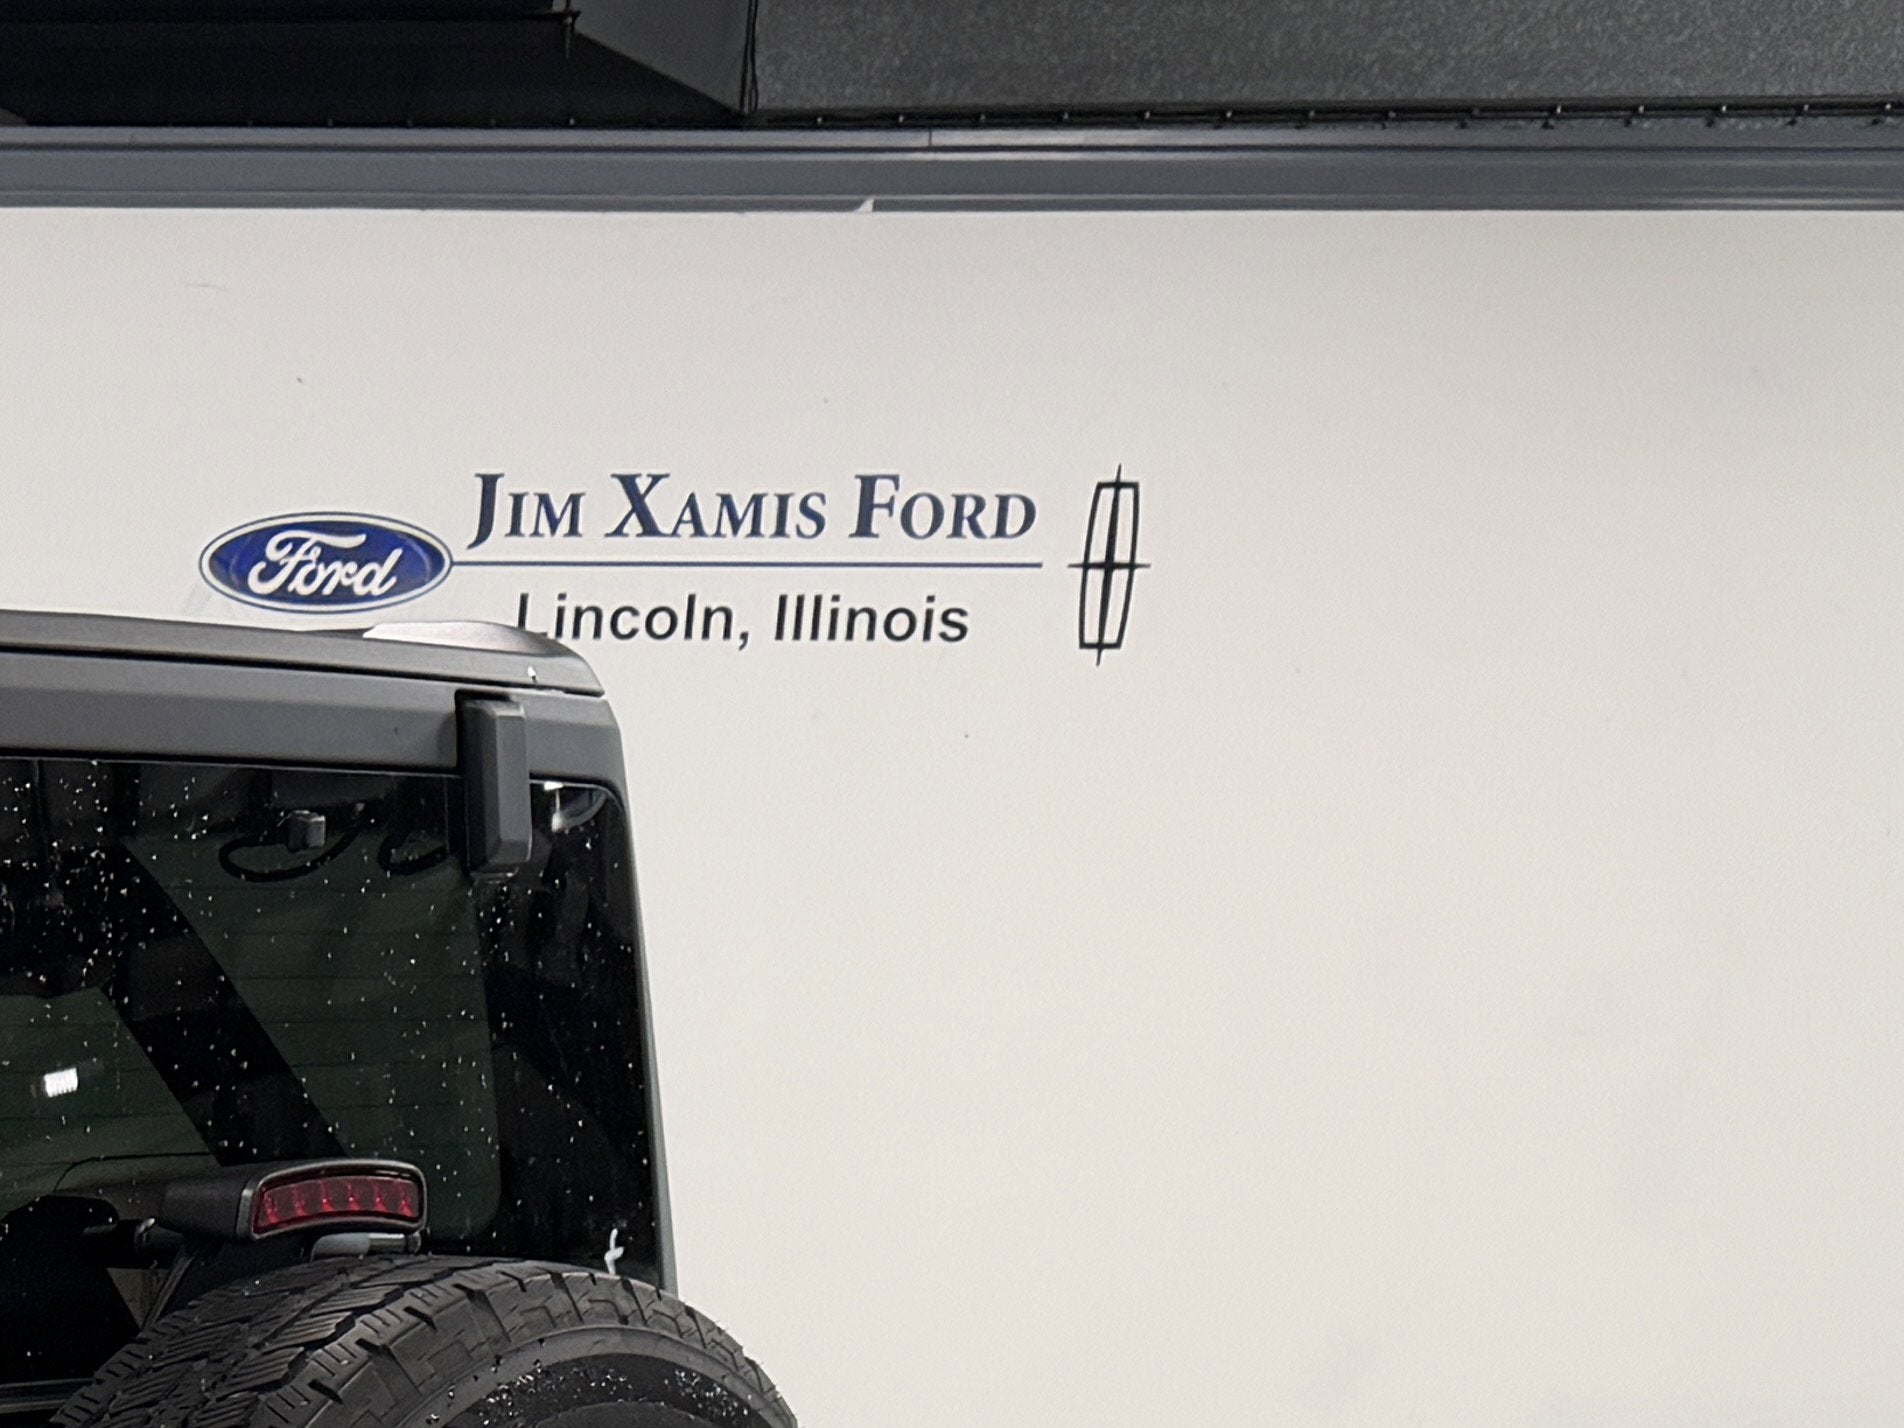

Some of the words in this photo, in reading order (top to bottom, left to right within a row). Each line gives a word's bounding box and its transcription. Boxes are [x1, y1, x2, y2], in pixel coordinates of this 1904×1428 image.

[468, 473, 585, 549] JIM
[605, 475, 825, 539] XAMIS
[849, 475, 1036, 541] FORD
[247, 534, 398, 598] Ford
[516, 592, 749, 651] Lincoln,
[774, 594, 969, 642] Illinois
